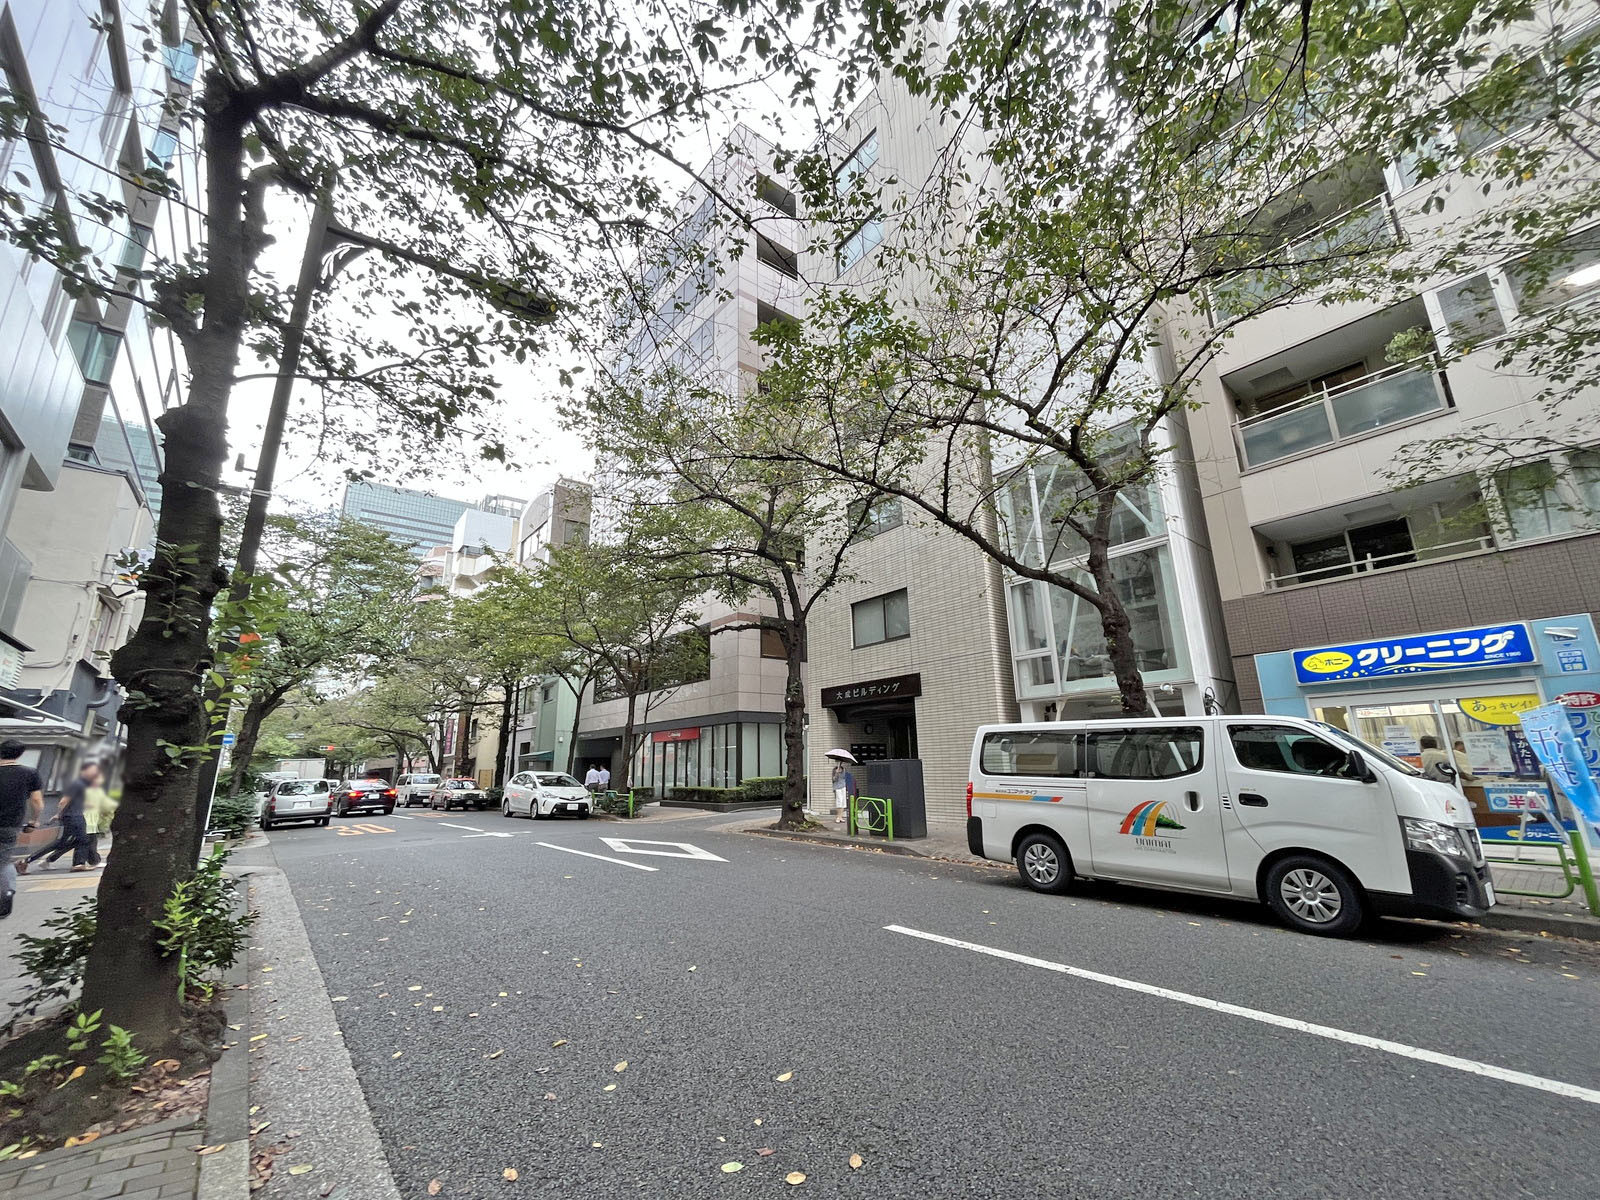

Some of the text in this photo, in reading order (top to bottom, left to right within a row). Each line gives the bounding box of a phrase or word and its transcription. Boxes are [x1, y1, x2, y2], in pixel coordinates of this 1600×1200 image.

[1357, 630, 1515, 666] クリーニング
[836, 682, 900, 700] 大成ビルディング
[324, 823, 397, 836] 30
